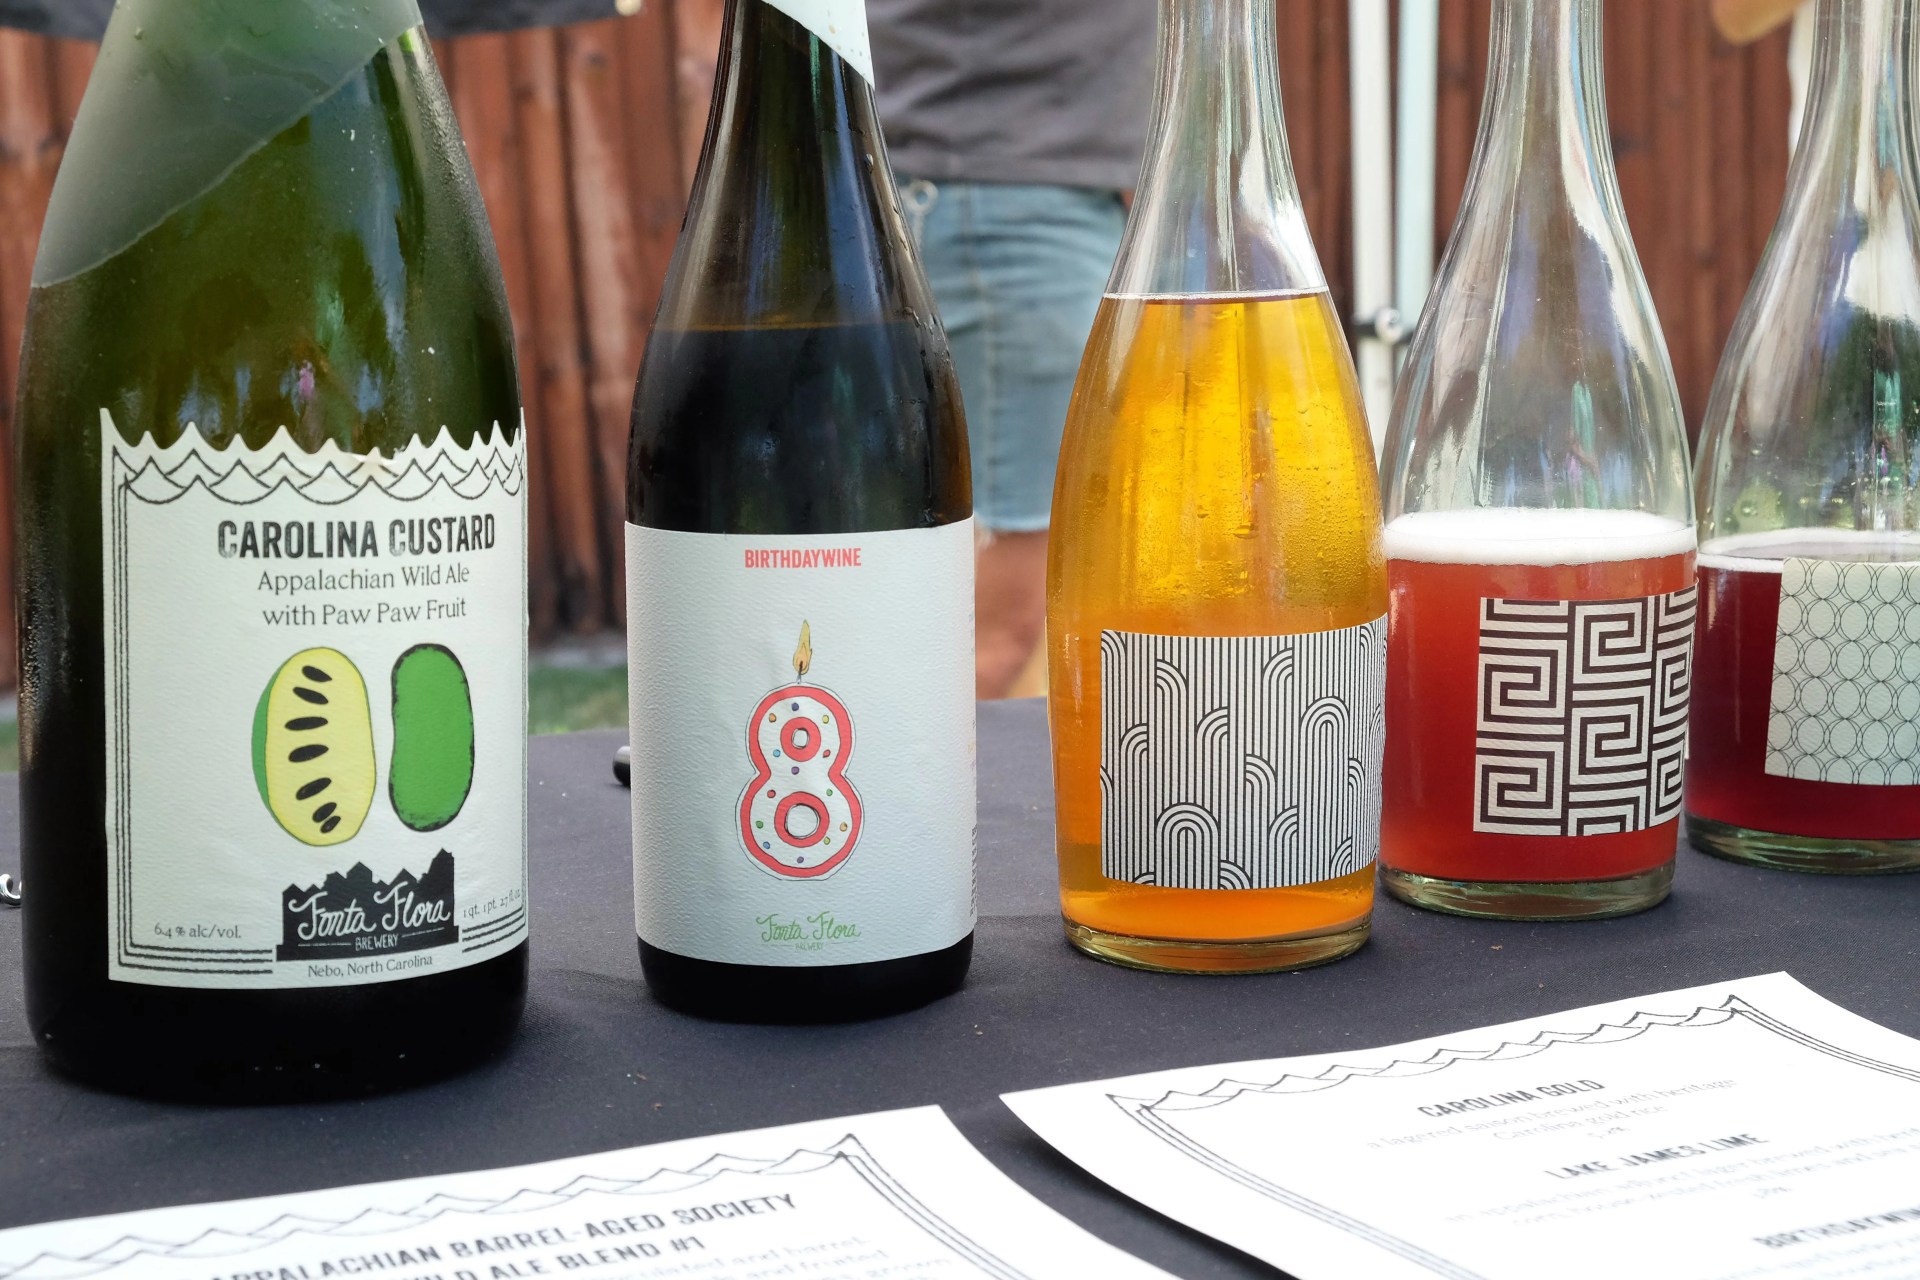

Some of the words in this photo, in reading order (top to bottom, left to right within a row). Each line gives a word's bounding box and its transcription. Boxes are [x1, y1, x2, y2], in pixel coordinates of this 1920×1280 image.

[217, 519, 379, 559] CAROLINA
[388, 513, 495, 556] CUSTARD
[744, 547, 862, 569] BIRTHDAYWINE
[257, 567, 395, 596] Appalachian
[401, 564, 441, 587] Wild
[445, 562, 470, 584] Ale
[262, 604, 316, 626] with
[322, 603, 371, 625] Paw
[377, 602, 421, 624] Paw
[426, 597, 467, 620] Fruit
[288, 890, 377, 940] Fonta
[373, 880, 451, 931] Flora
[756, 913, 809, 942] Fonta
[807, 911, 861, 940] Flora
[153, 922, 172, 939] 6.4
[175, 926, 186, 937] %
[188, 923, 242, 939] alc/vol.
[355, 933, 399, 951] BREWERY
[308, 964, 344, 979] Nebo,
[347, 961, 383, 976] North
[386, 954, 433, 972] Carolina
[1379, 1125, 1463, 1146] lagered
[1464, 1115, 1533, 1132] saison
[1527, 1100, 1611, 1119] brewed
[1608, 1091, 1660, 1105] with
[1652, 1079, 1738, 1098] heritage
[1416, 1089, 1543, 1118] CAROLINA
[1535, 1079, 1606, 1098] GOLD
[1493, 1119, 1585, 1140] Carolina
[1585, 1110, 1632, 1126] gold
[1629, 1105, 1669, 1118] rice
[1543, 1160, 1619, 1180] LAKE
[1617, 1144, 1707, 1168] JAMES
[1696, 1132, 1771, 1151] LIME
[670, 1192, 797, 1226] SOCIETY
[489, 1256, 551, 1280] ALE
[555, 1242, 662, 1271] BLEND
[668, 1234, 707, 1252] #1
